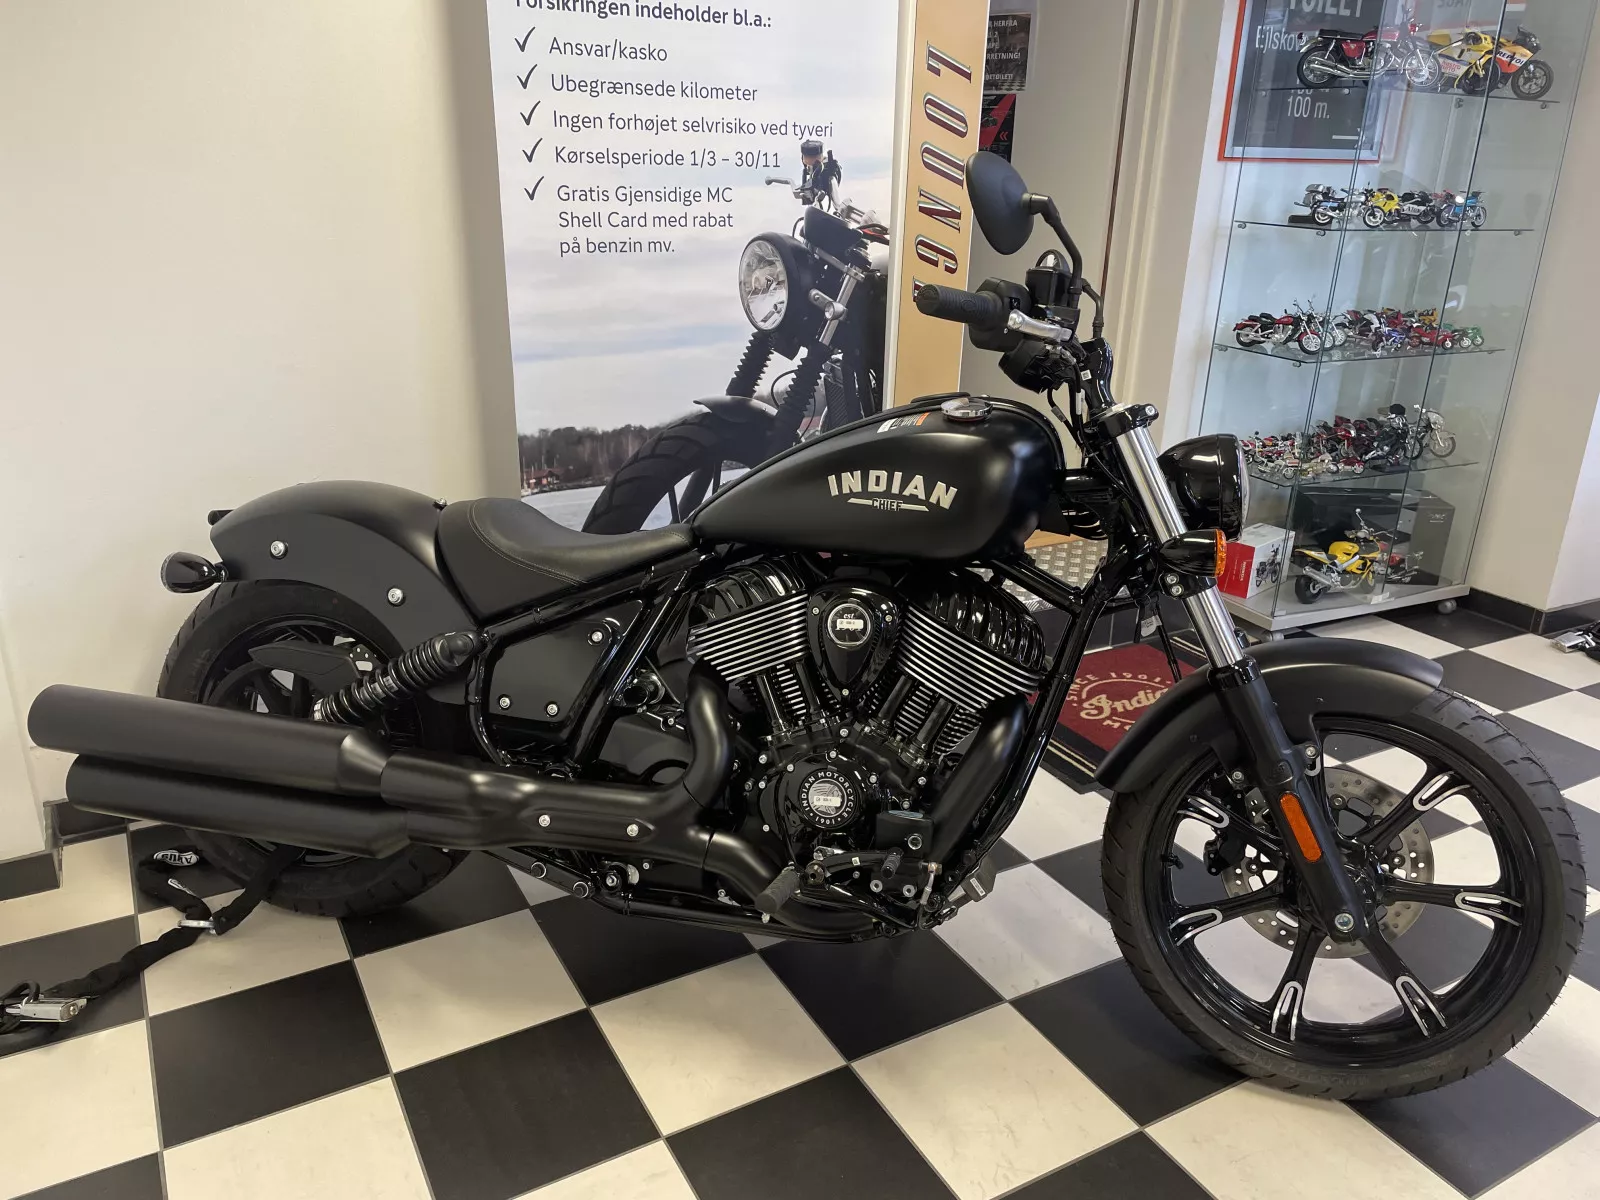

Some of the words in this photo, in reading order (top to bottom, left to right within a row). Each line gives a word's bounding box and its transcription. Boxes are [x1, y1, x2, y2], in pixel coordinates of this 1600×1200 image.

[636, 0, 728, 25] indeholder
[733, 8, 771, 28] bl.a.:
[549, 37, 668, 62] Ansvar/kasko
[551, 73, 676, 98] Ubegrænsede
[680, 81, 758, 101] kilometer
[1288, 95, 1311, 118] 100
[1314, 102, 1329, 119] m.
[553, 110, 603, 133] Ingen
[608, 113, 678, 136] forhøjet
[682, 117, 756, 135] selvrisiko
[761, 120, 788, 136] ved
[792, 121, 833, 139] tyveri
[555, 146, 685, 168] Kørselsperiode
[690, 149, 717, 168] 1/3
[735, 150, 781, 169] 30/11
[557, 185, 610, 202] Gratis
[615, 186, 702, 207] Gjensidige
[707, 187, 733, 203] MC
[558, 212, 603, 228] Shell
[607, 212, 648, 228] Card
[652, 212, 688, 228] med
[692, 212, 734, 228] rabat
[559, 236, 581, 258] på
[586, 238, 643, 254] benzin
[648, 240, 675, 253] mv.
[827, 469, 958, 510] INDIAN
[871, 497, 903, 512] CHIEF
[1066, 674, 1099, 701] SINCE
[1110, 672, 1162, 682] 1901
[801, 776, 816, 811] INDIAN
[818, 771, 855, 818] MOTORCYCLE
[815, 816, 835, 825] 1901
